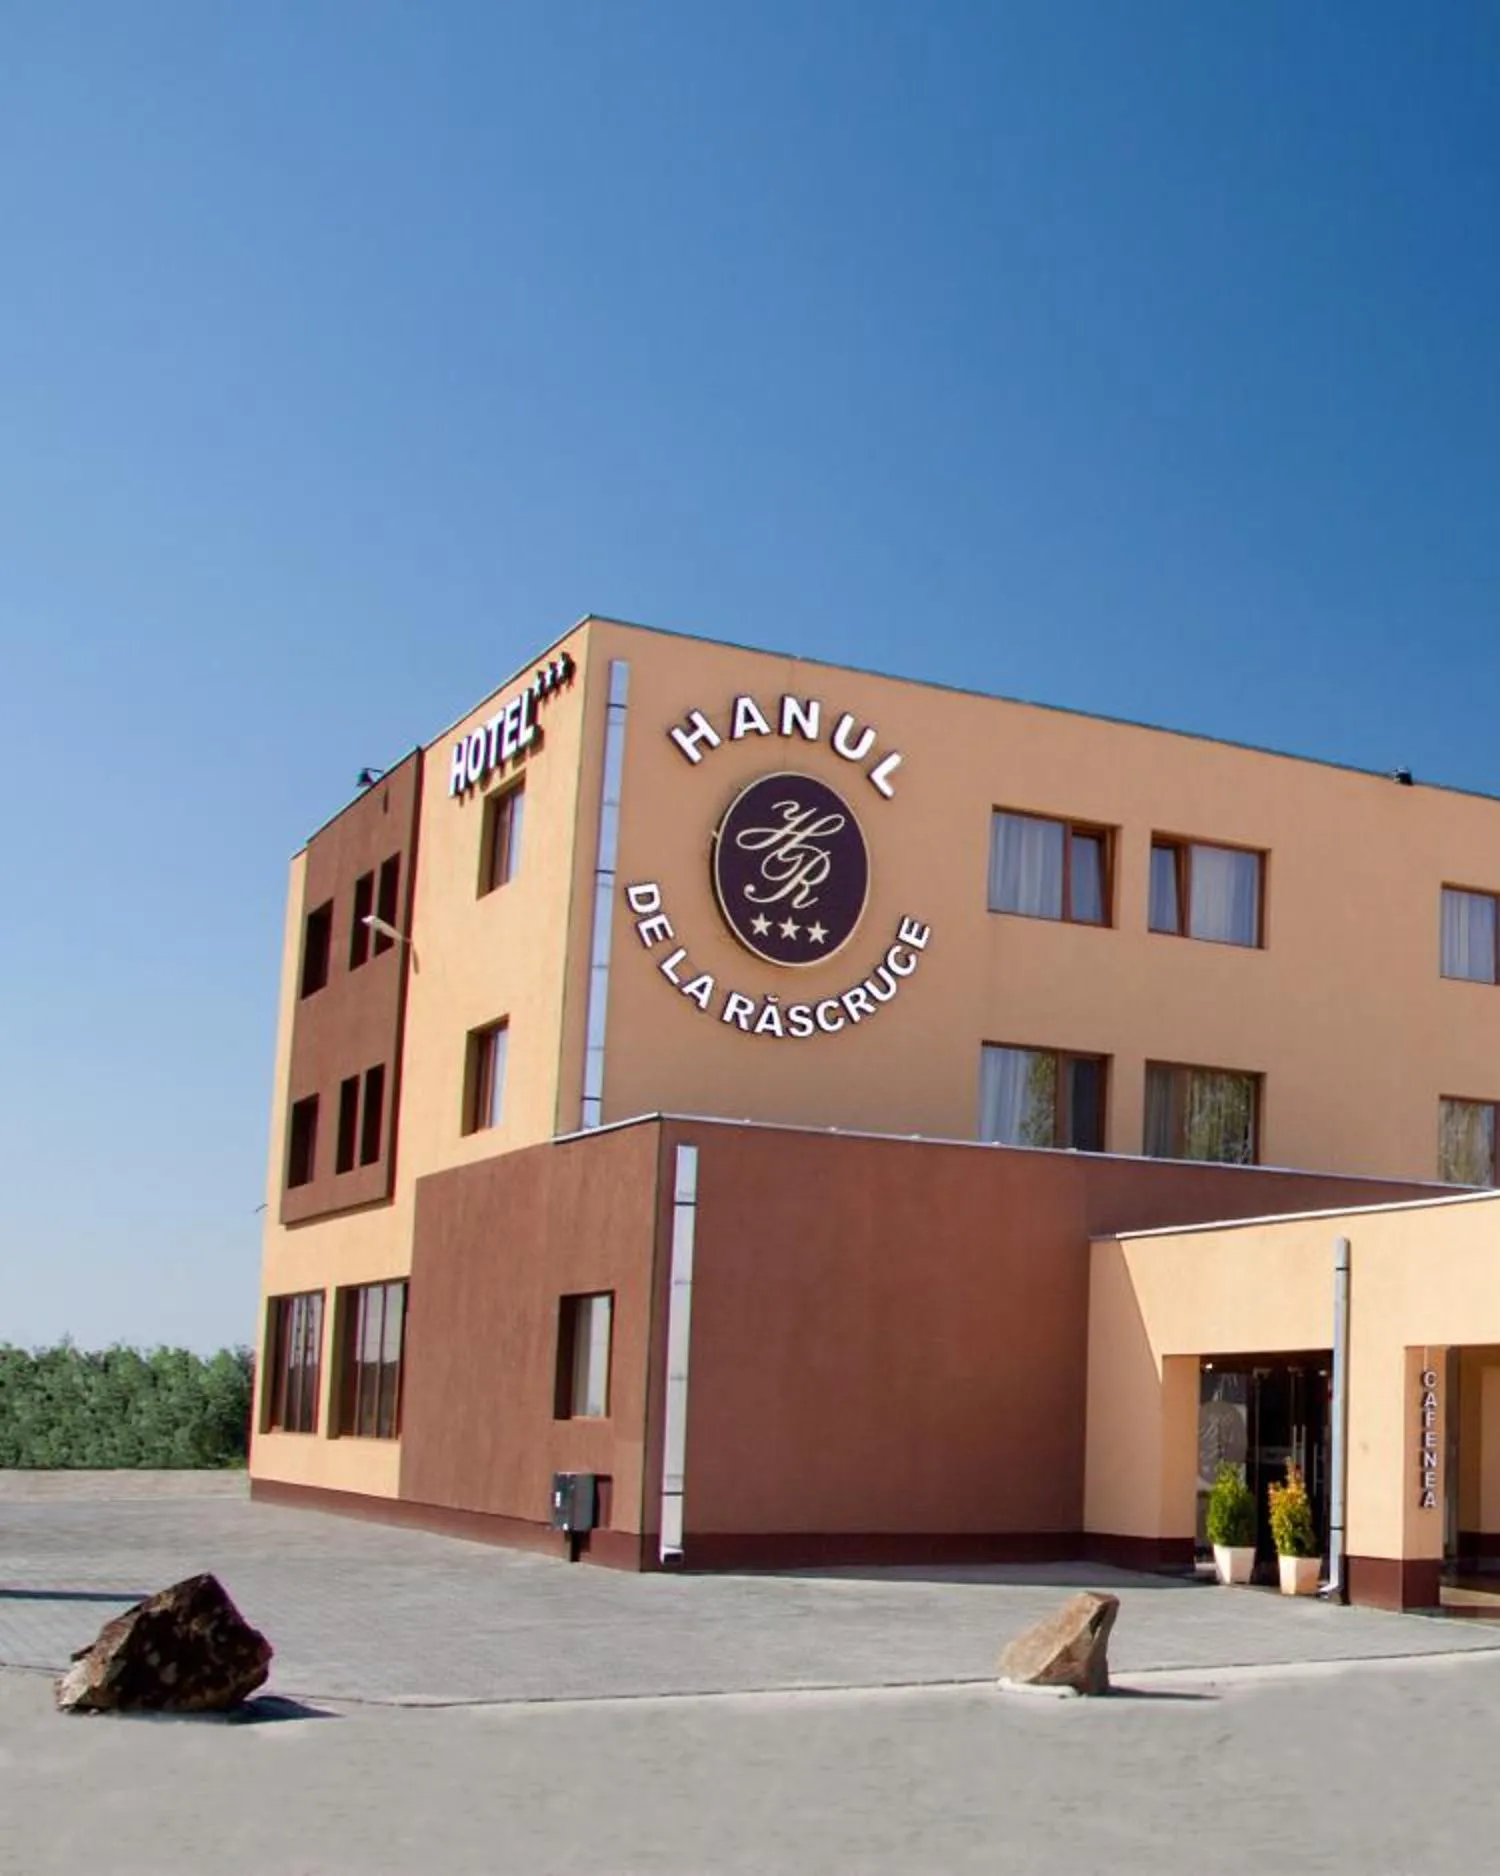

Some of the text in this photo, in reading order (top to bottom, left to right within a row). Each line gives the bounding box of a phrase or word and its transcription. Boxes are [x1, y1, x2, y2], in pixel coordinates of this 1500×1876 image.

[449, 688, 535, 797] HOTEL
[671, 697, 905, 799] HANUL
[627, 883, 930, 1038] DE LA RĂSCRUCE
[1421, 1371, 1438, 1509] CAFENEA
